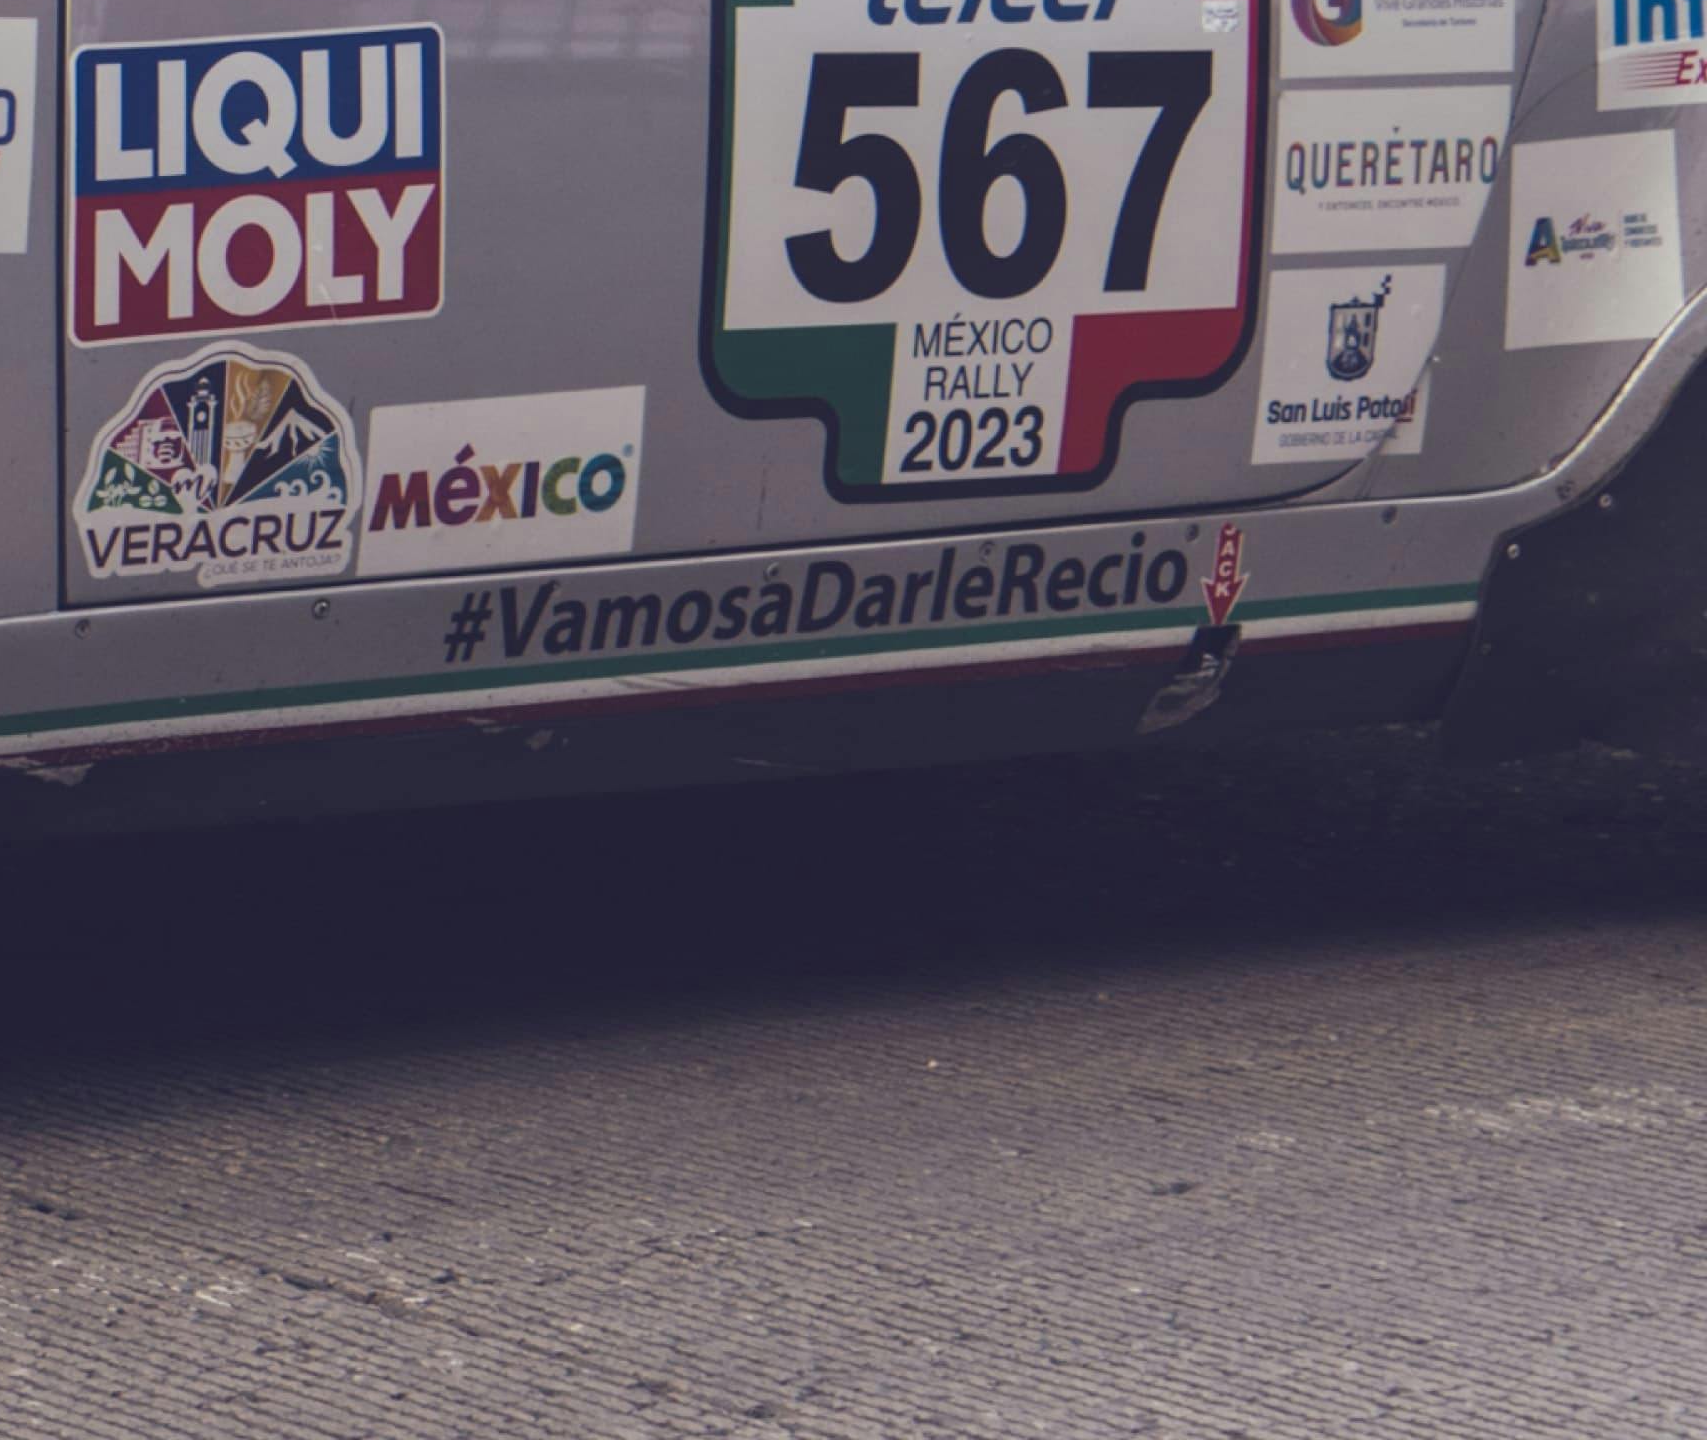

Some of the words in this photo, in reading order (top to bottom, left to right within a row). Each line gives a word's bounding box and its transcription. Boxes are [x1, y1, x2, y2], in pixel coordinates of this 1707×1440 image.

[94, 42, 424, 181] LIQUI
[784, 47, 1214, 304] 567
[94, 184, 436, 327] MOLY
[913, 314, 1054, 359] MÉXICO
[923, 363, 1034, 402] RALLY
[1267, 399, 1307, 424] San
[1310, 395, 1352, 423] Luis
[900, 406, 1044, 472] 2023
[87, 509, 345, 569] VERACRUZ
